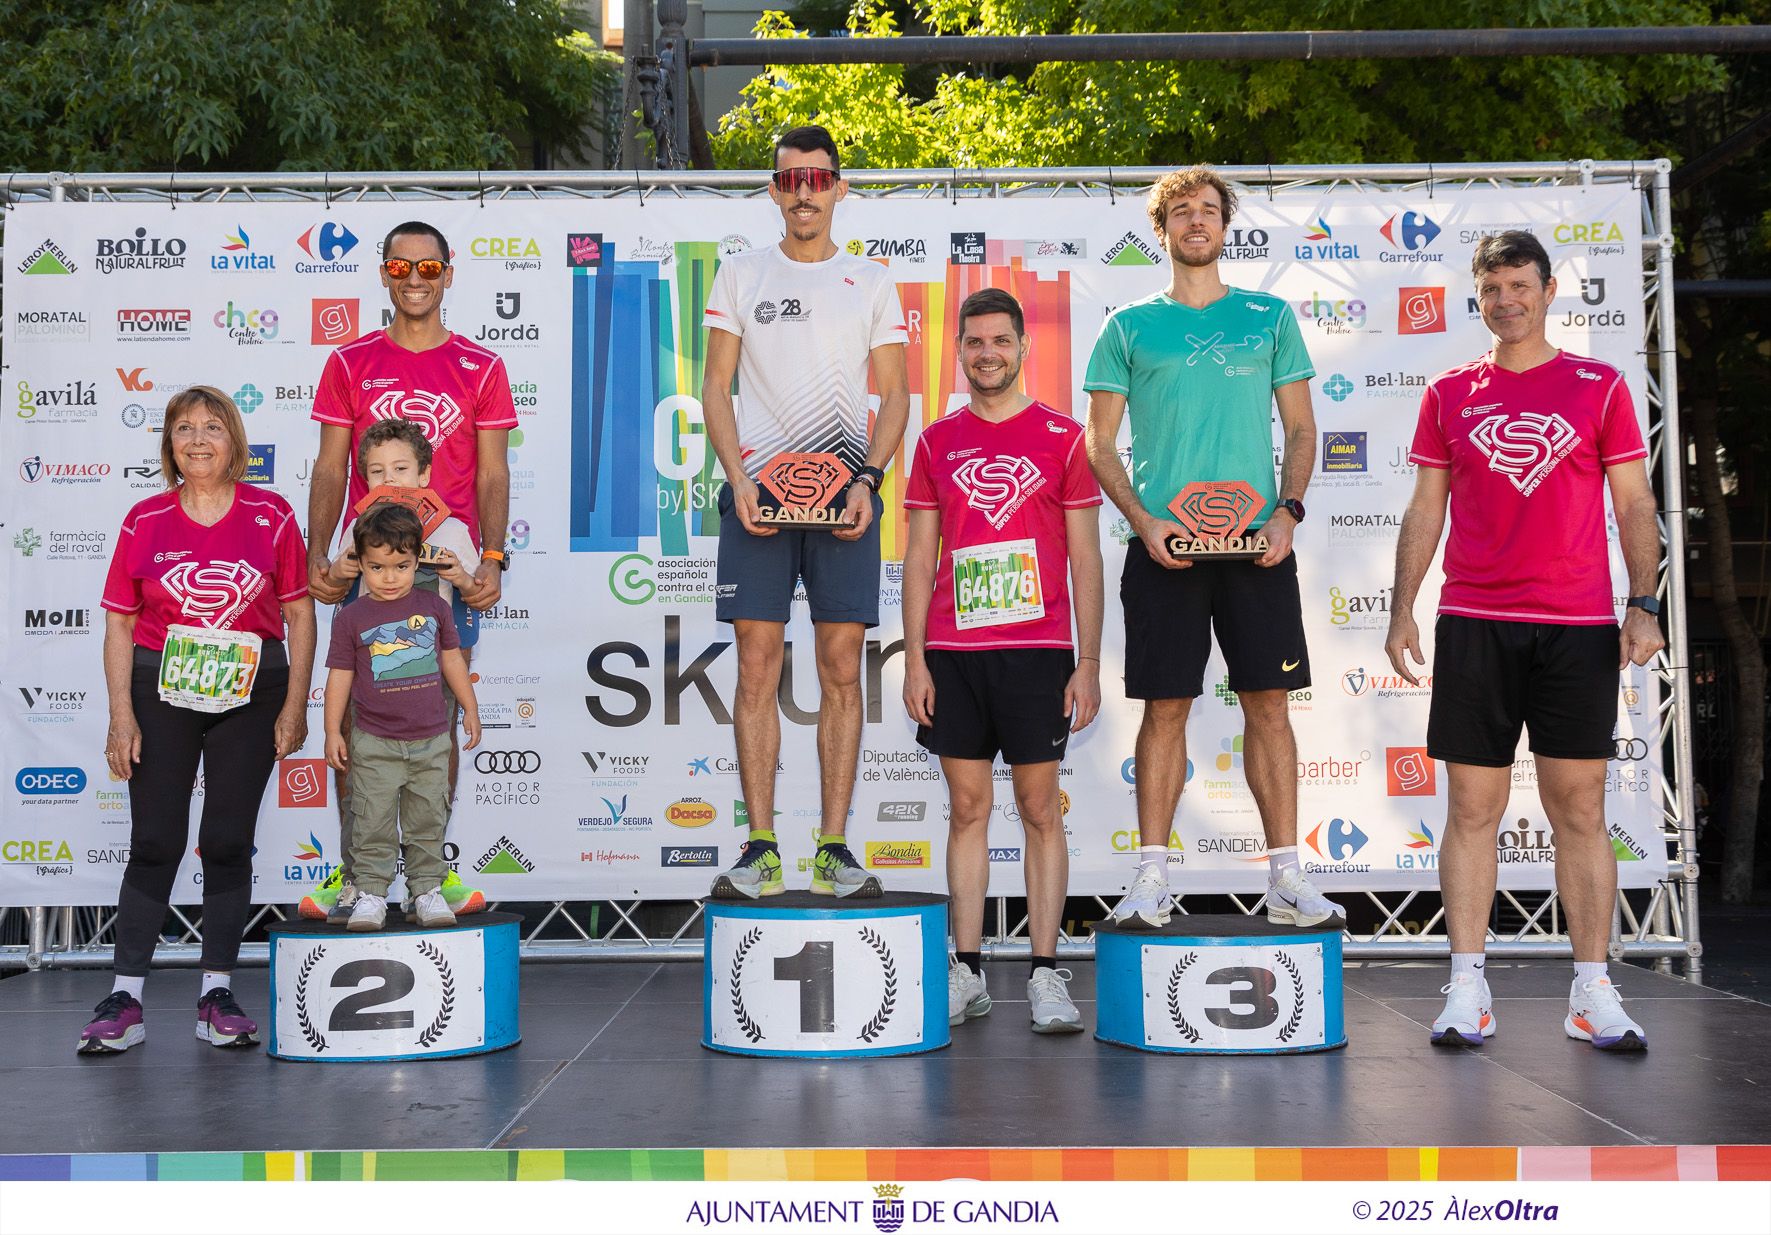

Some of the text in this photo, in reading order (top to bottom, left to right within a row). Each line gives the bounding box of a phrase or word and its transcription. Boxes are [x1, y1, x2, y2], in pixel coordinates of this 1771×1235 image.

[1554, 222, 1625, 244] CREA
[470, 238, 542, 257] CREA
[865, 239, 926, 257] ZUMBA
[1101, 231, 1162, 265] LEROY MERLIN
[18, 238, 79, 274] LEROY MERLIN
[1379, 251, 1444, 264] Carrefour
[96, 255, 187, 275] NATURALFRUIT
[295, 261, 360, 275] Carrefour
[780, 299, 802, 316] 28
[18, 311, 88, 323] MORATAL
[118, 312, 189, 332] HOME
[18, 324, 88, 336] PALOMINO
[116, 335, 191, 344] www.latiendahome.com
[510, 381, 538, 393] acia
[17, 380, 98, 419] gavilá
[514, 396, 538, 407] seo
[247, 457, 264, 467] MAR
[44, 463, 112, 476] VIMACO
[51, 476, 102, 486] Refrigeración
[657, 483, 684, 516] by
[1330, 515, 1402, 527] MORATAL
[49, 530, 107, 542] farmàcia
[49, 543, 104, 553] del raval
[1169, 535, 1270, 556] GANDIA
[657, 558, 717, 569] asociación
[657, 570, 709, 583] española
[657, 583, 692, 593] contra
[694, 583, 704, 593] el
[958, 569, 1035, 608] 64876
[658, 593, 713, 604] en Gandia
[24, 608, 85, 629] Moll
[164, 656, 254, 691] 64873
[480, 674, 542, 685] Vicente Giner
[46, 691, 86, 702] VICKY
[1288, 691, 1313, 702] seo
[1377, 690, 1432, 700] Refrigeración
[49, 702, 83, 710] FOODS
[609, 756, 649, 767] VICKY
[863, 749, 929, 767] Diputació
[613, 767, 646, 775] FOODS
[863, 767, 941, 782] de València
[475, 782, 541, 793] MOTOR
[21, 797, 79, 807] your data partner
[475, 791, 541, 805] PACÍFICO
[669, 807, 714, 821] Dacsa
[883, 804, 920, 816] 42K
[578, 816, 654, 827] VERDEJO SEGURA
[1609, 822, 1649, 861] MERLIN
[2, 840, 74, 862] CREA
[472, 835, 536, 873] LEROY MERLIN
[596, 849, 641, 866] Hofmann
[875, 842, 922, 859] Bondia
[1304, 860, 1372, 875] Carrefour
[773, 940, 836, 1034] 1
[328, 959, 416, 1033] 2
[1203, 966, 1281, 1030] 3
